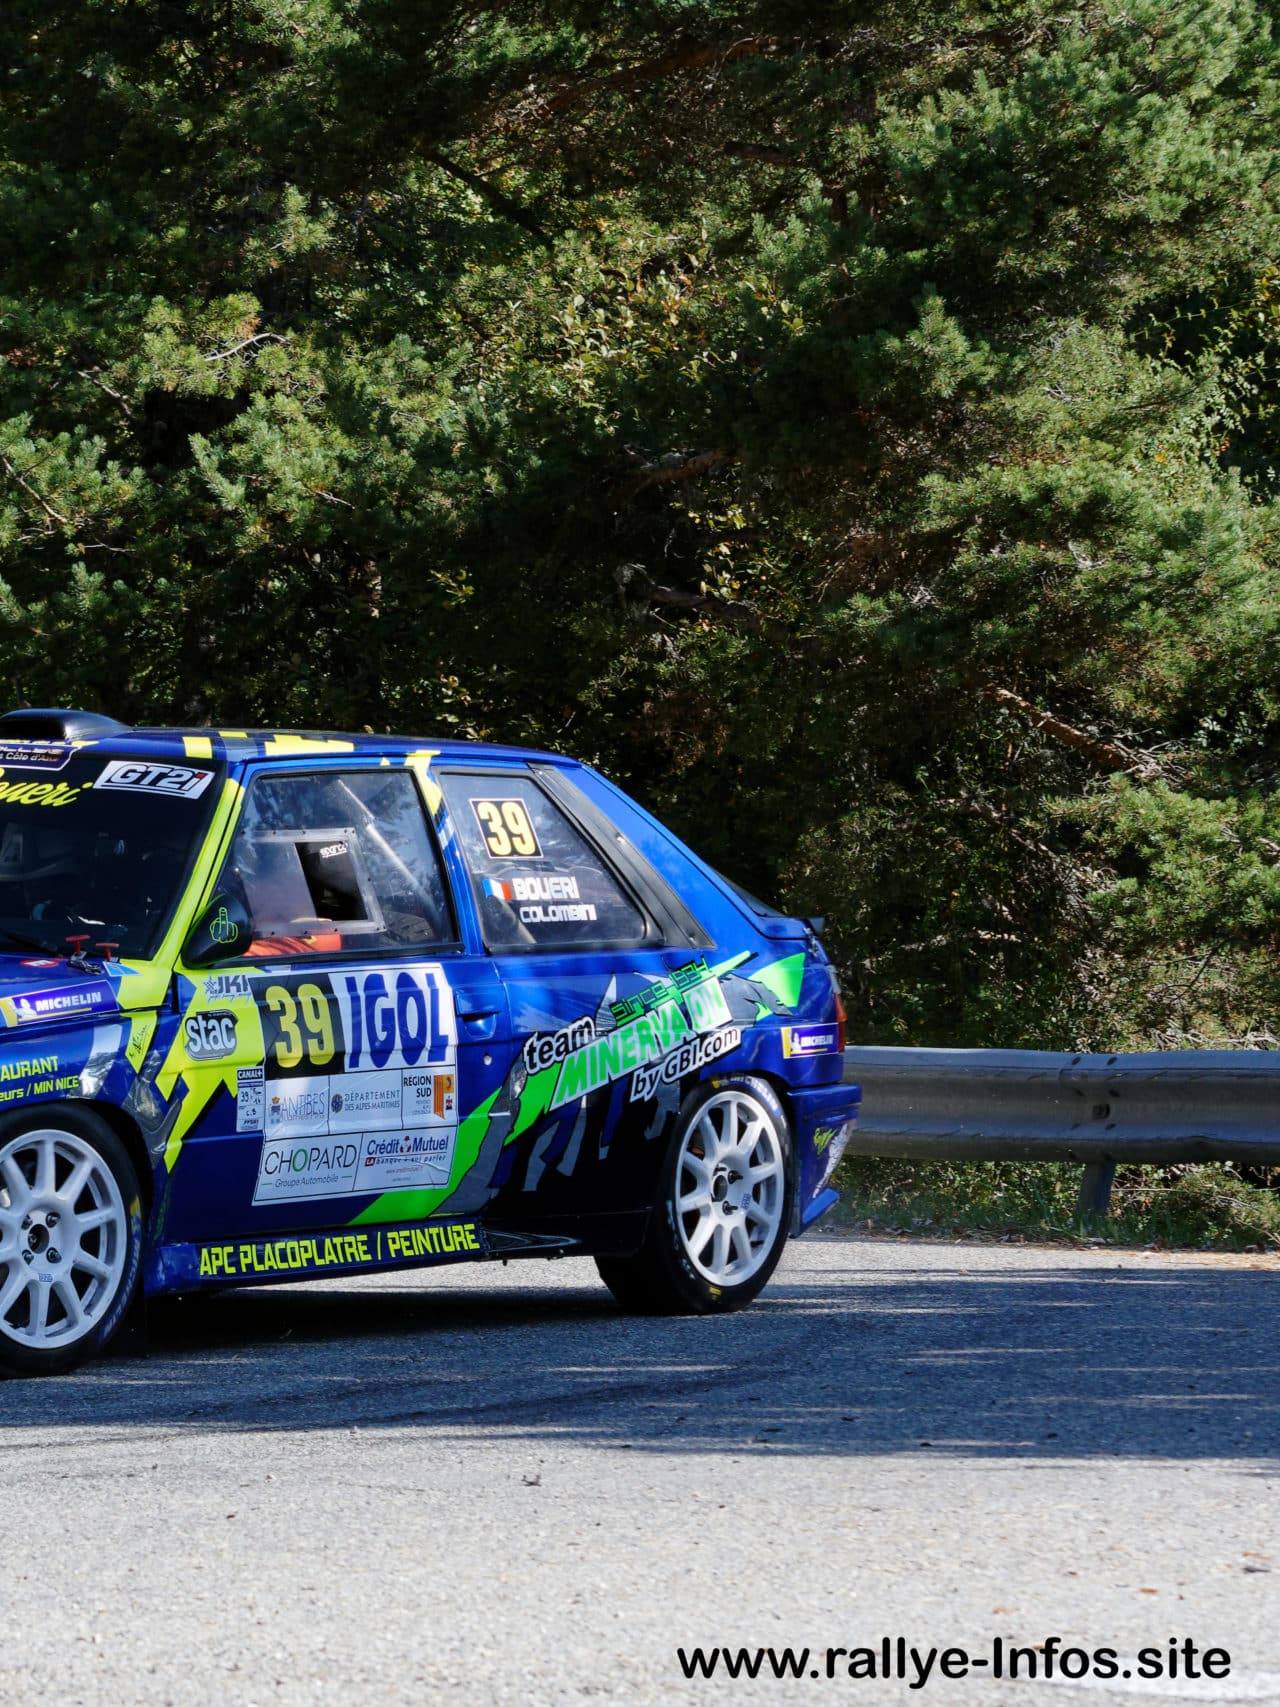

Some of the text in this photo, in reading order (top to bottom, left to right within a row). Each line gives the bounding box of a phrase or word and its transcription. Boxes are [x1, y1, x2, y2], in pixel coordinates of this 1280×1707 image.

[106, 763, 208, 791] GT2i
[477, 802, 536, 856] 39
[512, 876, 580, 900] BOUERI
[36, 992, 102, 1012] MICHELIN
[611, 980, 669, 1020] since
[186, 1014, 236, 1053] stac
[265, 983, 336, 1068] 39
[345, 971, 450, 1069] IGOL
[525, 1017, 594, 1072] team
[555, 977, 730, 1105] MINERVA OIL
[238, 1070, 263, 1079] CANAL+
[633, 1029, 739, 1098] by GBI.com
[34, 1080, 54, 1094] MIN
[55, 1075, 80, 1090] NICE
[416, 1087, 432, 1098] SUD
[281, 1092, 325, 1117] ANTIBES
[264, 1144, 358, 1175] CHOPARD
[367, 1135, 449, 1156] Crédit Mutuel
[275, 1173, 339, 1188] Groupe Automobile
[199, 1246, 236, 1276] APC
[239, 1234, 372, 1273] PLACOPLATRE
[386, 1223, 480, 1258] PEINTURE
